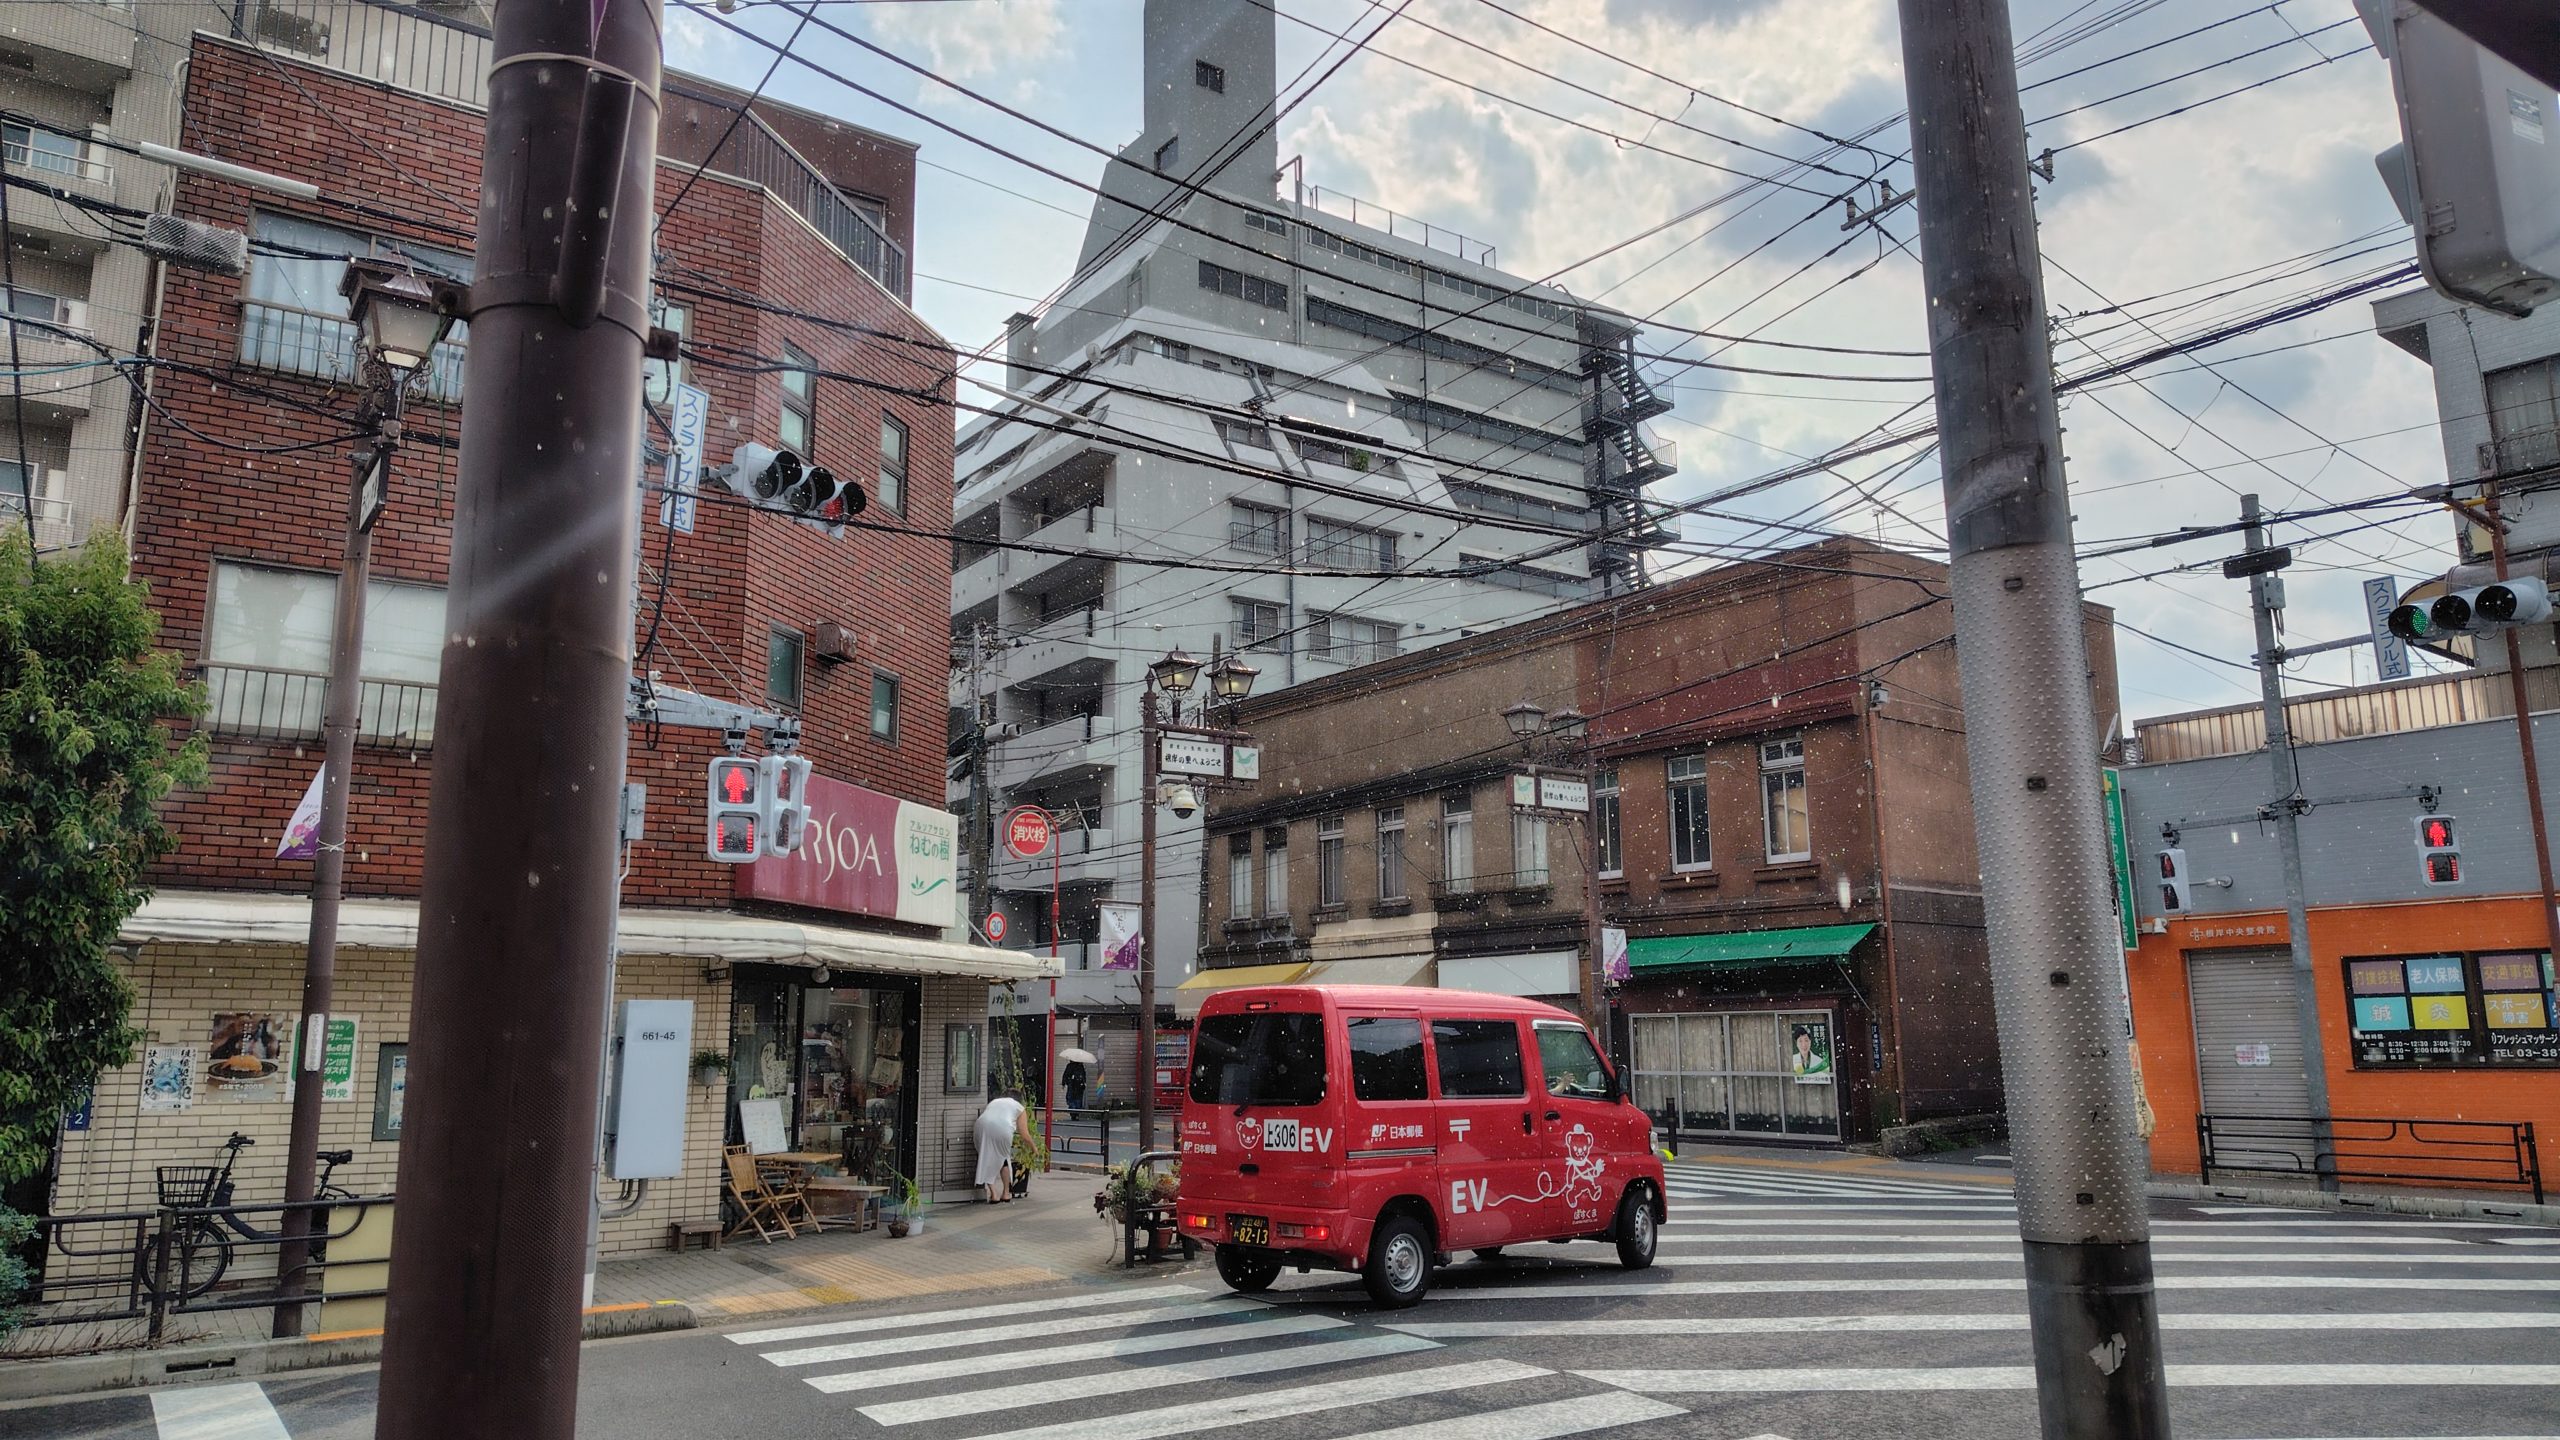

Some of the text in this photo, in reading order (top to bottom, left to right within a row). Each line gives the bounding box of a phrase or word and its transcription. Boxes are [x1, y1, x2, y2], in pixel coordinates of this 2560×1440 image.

[1013, 825, 1047, 843] 消火栓
[799, 811, 883, 884] RSOA
[909, 832, 951, 861] ねむの樹
[990, 920, 1003, 933] 30
[2410, 966, 2463, 984] 老人保険
[2482, 963, 2537, 981] 交通事故
[2488, 998, 2541, 1011] スポーツ
[642, 1031, 676, 1041] 661-45
[2491, 1032, 2559, 1045] リフレッシュマッサージ
[2493, 1048, 2560, 1058] TEL 03-38
[321, 1086, 349, 1099] 明党
[74, 1113, 84, 1125] 2
[1265, 1123, 1333, 1153] 上306 EV
[1371, 1124, 1387, 1138] JP
[1390, 1125, 1424, 1140] 日本郵便
[1452, 1177, 1488, 1214] EV
